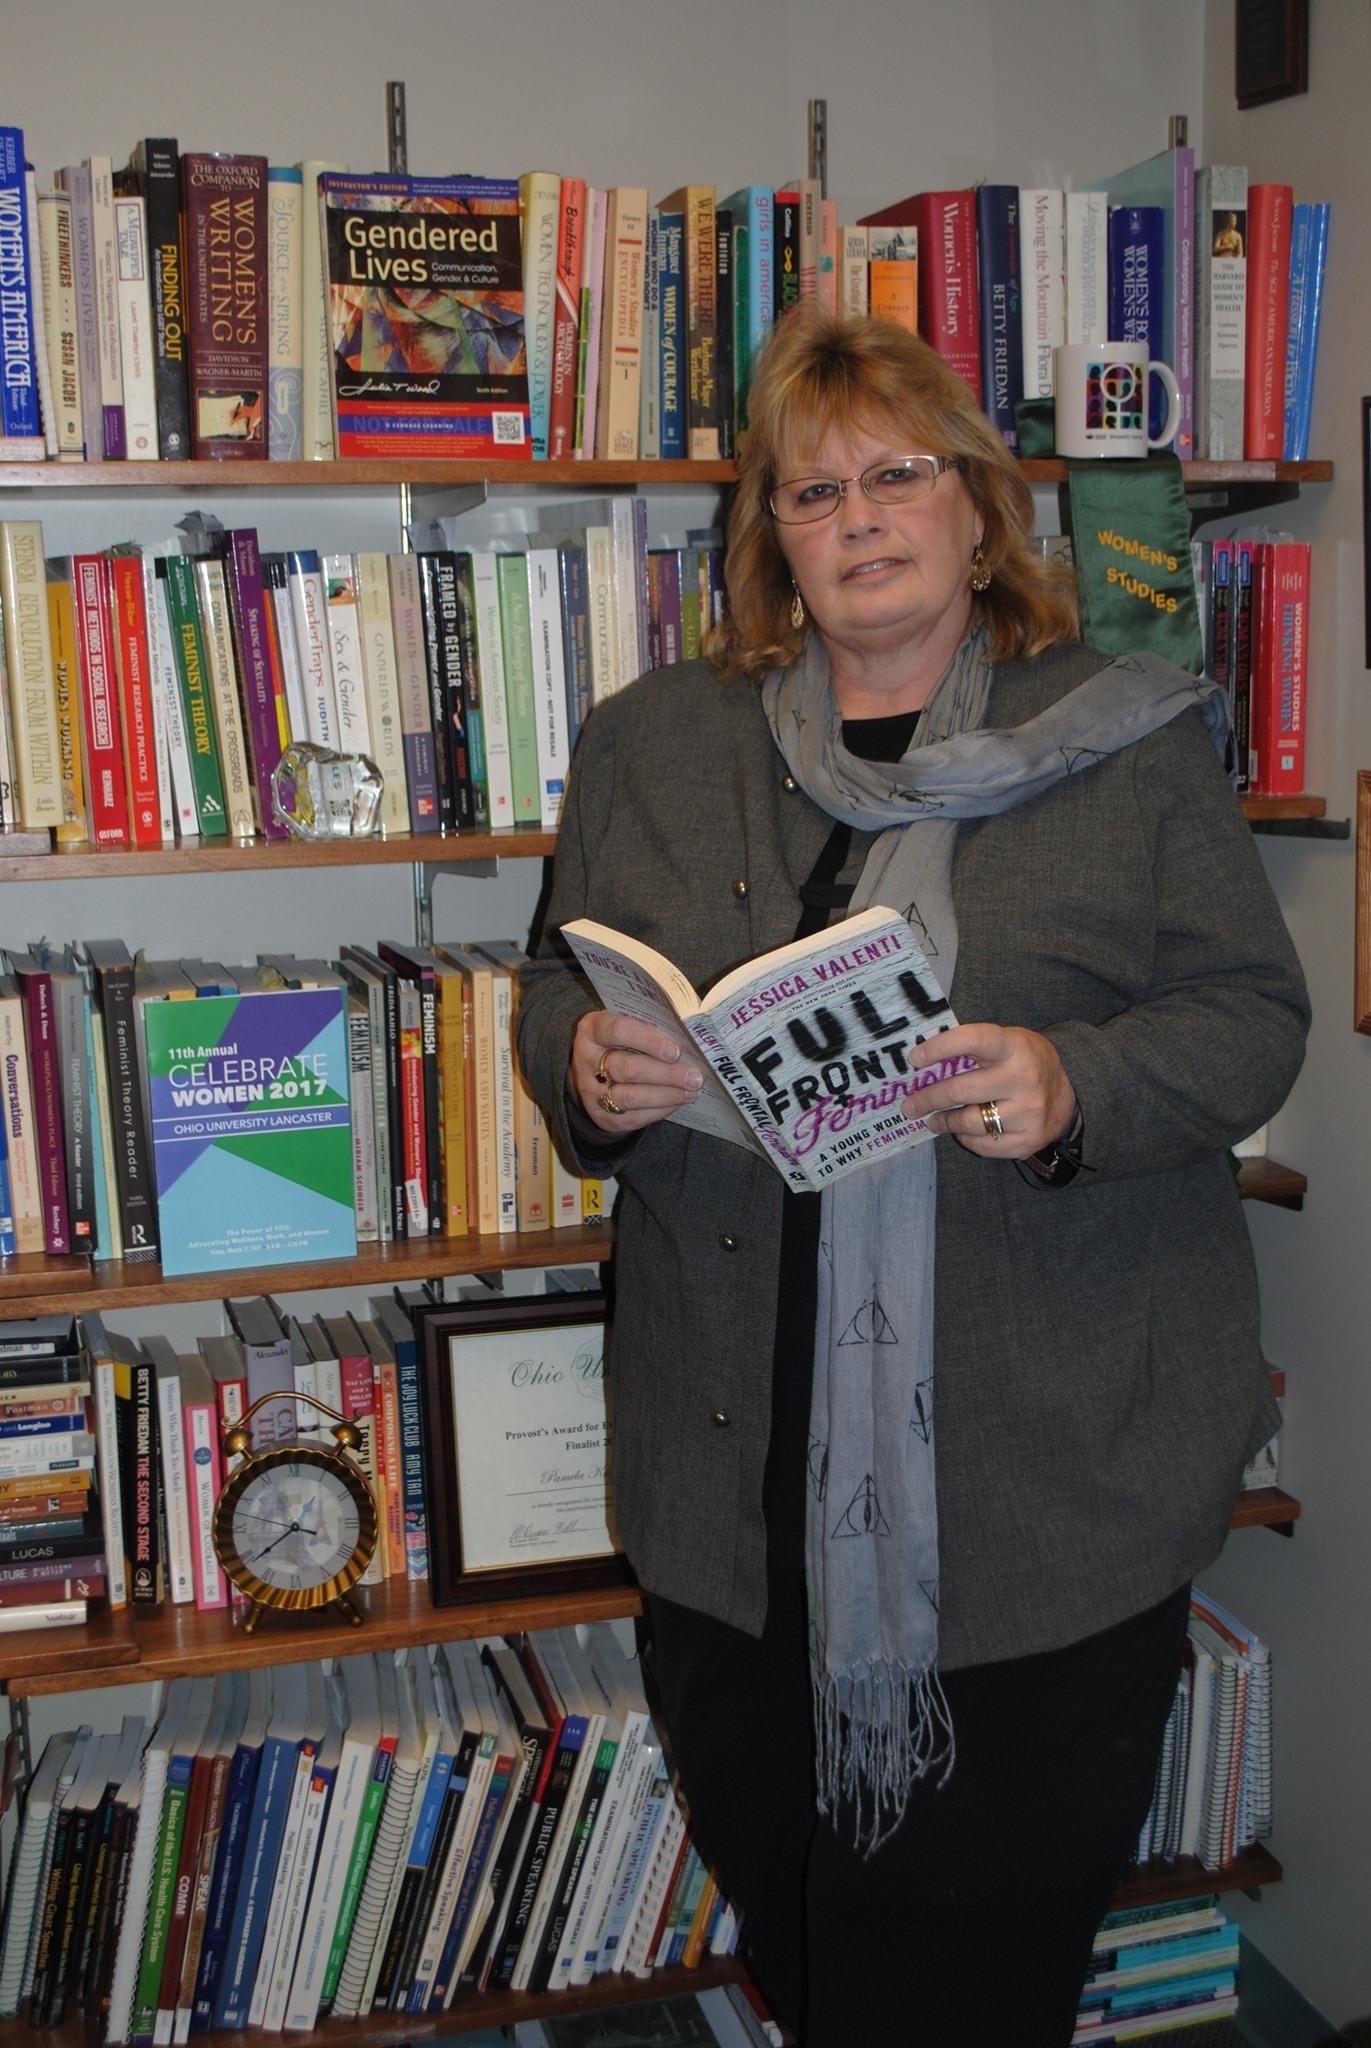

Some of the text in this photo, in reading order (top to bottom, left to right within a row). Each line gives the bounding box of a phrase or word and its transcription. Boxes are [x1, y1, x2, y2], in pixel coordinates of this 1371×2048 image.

[190, 173, 261, 190] COMPANION
[192, 163, 258, 177] THE OXFORD
[344, 216, 499, 253] Gendered
[804, 192, 813, 237] DICKERSON
[119, 229, 129, 259] TALE
[349, 248, 429, 283] Lives
[431, 261, 498, 273] Communication,
[697, 197, 714, 329] WE WERE THERE
[754, 195, 774, 325] girls in america
[0, 187, 31, 388] WOMEN'S AMERICA
[77, 217, 95, 336] WOMEN'S LIVES
[197, 213, 208, 325] IN THE UNITED STATES
[210, 197, 234, 343] WRITING
[234, 197, 257, 346] WOMEN'S
[431, 273, 500, 285] Gender, & Culture
[942, 202, 961, 338] Women's History
[1033, 195, 1051, 380] Moving the Mountain Flora
[1179, 238, 1190, 305] Contemporary
[1212, 272, 1245, 282] HARVARD
[57, 209, 77, 409] FREETHINKERS SUSAN JACOBY
[161, 244, 182, 361] FINDING OUT
[617, 251, 629, 337] ENCYCLOPEDIA
[628, 252, 641, 338] Women's Studies
[992, 284, 1009, 410] BETTY FRIEDAN
[1180, 306, 1190, 348] Women's
[195, 367, 264, 378] WAGNER-MARTIN
[208, 355, 250, 364] DAVIDSON
[1180, 350, 1189, 378] Health
[475, 386, 509, 395] Tenth Edition
[10, 421, 33, 431] Oxford
[1097, 530, 1178, 572] WOMEN'S
[1106, 567, 1178, 614] STUDIES
[439, 566, 462, 688] FRAMED by GENDER
[596, 584, 611, 682] Communicating
[1281, 602, 1293, 672] THINKING
[13, 533, 54, 785] STEINEM REVOLUTION FROM WITHIN
[123, 572, 148, 782] Hesse-Biber FEMINIST RESEARCH PRACTICE
[303, 579, 330, 742] GenderTraps JUDITH
[334, 630, 356, 729] Sex & Gender
[1292, 602, 1302, 732] WOMEN'S STUDIES
[164, 666, 182, 749] FEMINIST THEORY
[181, 623, 211, 756] FEMINIST THEORY
[1280, 677, 1291, 733] WOMEN
[102, 770, 114, 807] REINHARZ
[730, 934, 902, 1029] JESSICA VALENTI
[350, 1017, 371, 1073] FEMINISM
[422, 993, 436, 1055] FEMINISM
[741, 970, 951, 1095] FULL
[167, 1042, 239, 1061] 11th Annual
[168, 1052, 329, 1089] CELEBRATE
[501, 1047, 512, 1092] Survival
[5, 1054, 24, 1138] Conversations
[171, 1078, 328, 1108] WOMEN 2017
[692, 1023, 725, 1052] VALENTI
[713, 1056, 743, 1084] FULL
[732, 1086, 772, 1128] FRONTAL
[116, 1020, 140, 1180] Feminist Theory Reader
[174, 1111, 333, 1136] OHIO UNIVERSITY LANCASTER
[502, 1095, 512, 1106] in
[502, 1109, 513, 1126] the
[791, 1052, 980, 1158] Feminism
[500, 1129, 513, 1178] Academy
[531, 1137, 541, 1176] Freeman
[817, 1118, 928, 1178] TO WHY FEMINISM
[819, 1153, 828, 1163] A
[830, 1129, 871, 1154] YOUNG
[508, 1358, 565, 1388] Ohio
[6, 1404, 48, 1415] Postman
[17, 1420, 52, 1432] Longino
[401, 1365, 422, 1496] THE JOY LUCK CLUB AMY TAN
[504, 1422, 599, 1441] Provost's Award for
[137, 1368, 150, 1561] BETTY FRIEDAN THE SECOND STAGE
[565, 1438, 601, 1451] Finalist
[540, 1468, 585, 1486] Pamela
[12, 1546, 54, 1560] LUCAS
[377, 1754, 389, 1780] PEARSON
[583, 1814, 595, 1829] ART
[586, 1797, 599, 1813] THE
[634, 1803, 656, 1844] PUBLIC
[299, 1827, 314, 1867] Invitation
[515, 1807, 558, 1926] PUBLIC SPEAKING
[572, 1839, 587, 1867] PUBLIC
[148, 1799, 181, 1963] Basics of the U.S. Health Care System
[175, 1875, 191, 1916] COMM
[194, 1874, 210, 1912] SPEAK
[292, 1878, 305, 1907] Human
[431, 1848, 465, 1933] Effective Speaking
[562, 1867, 580, 1904] SPEAKING
[616, 1845, 642, 1906] SPEAKING
[38, 1868, 63, 1969] Writing Great Speeches
[280, 1909, 299, 1970] Communication
[547, 1916, 565, 1952] LUCAS
